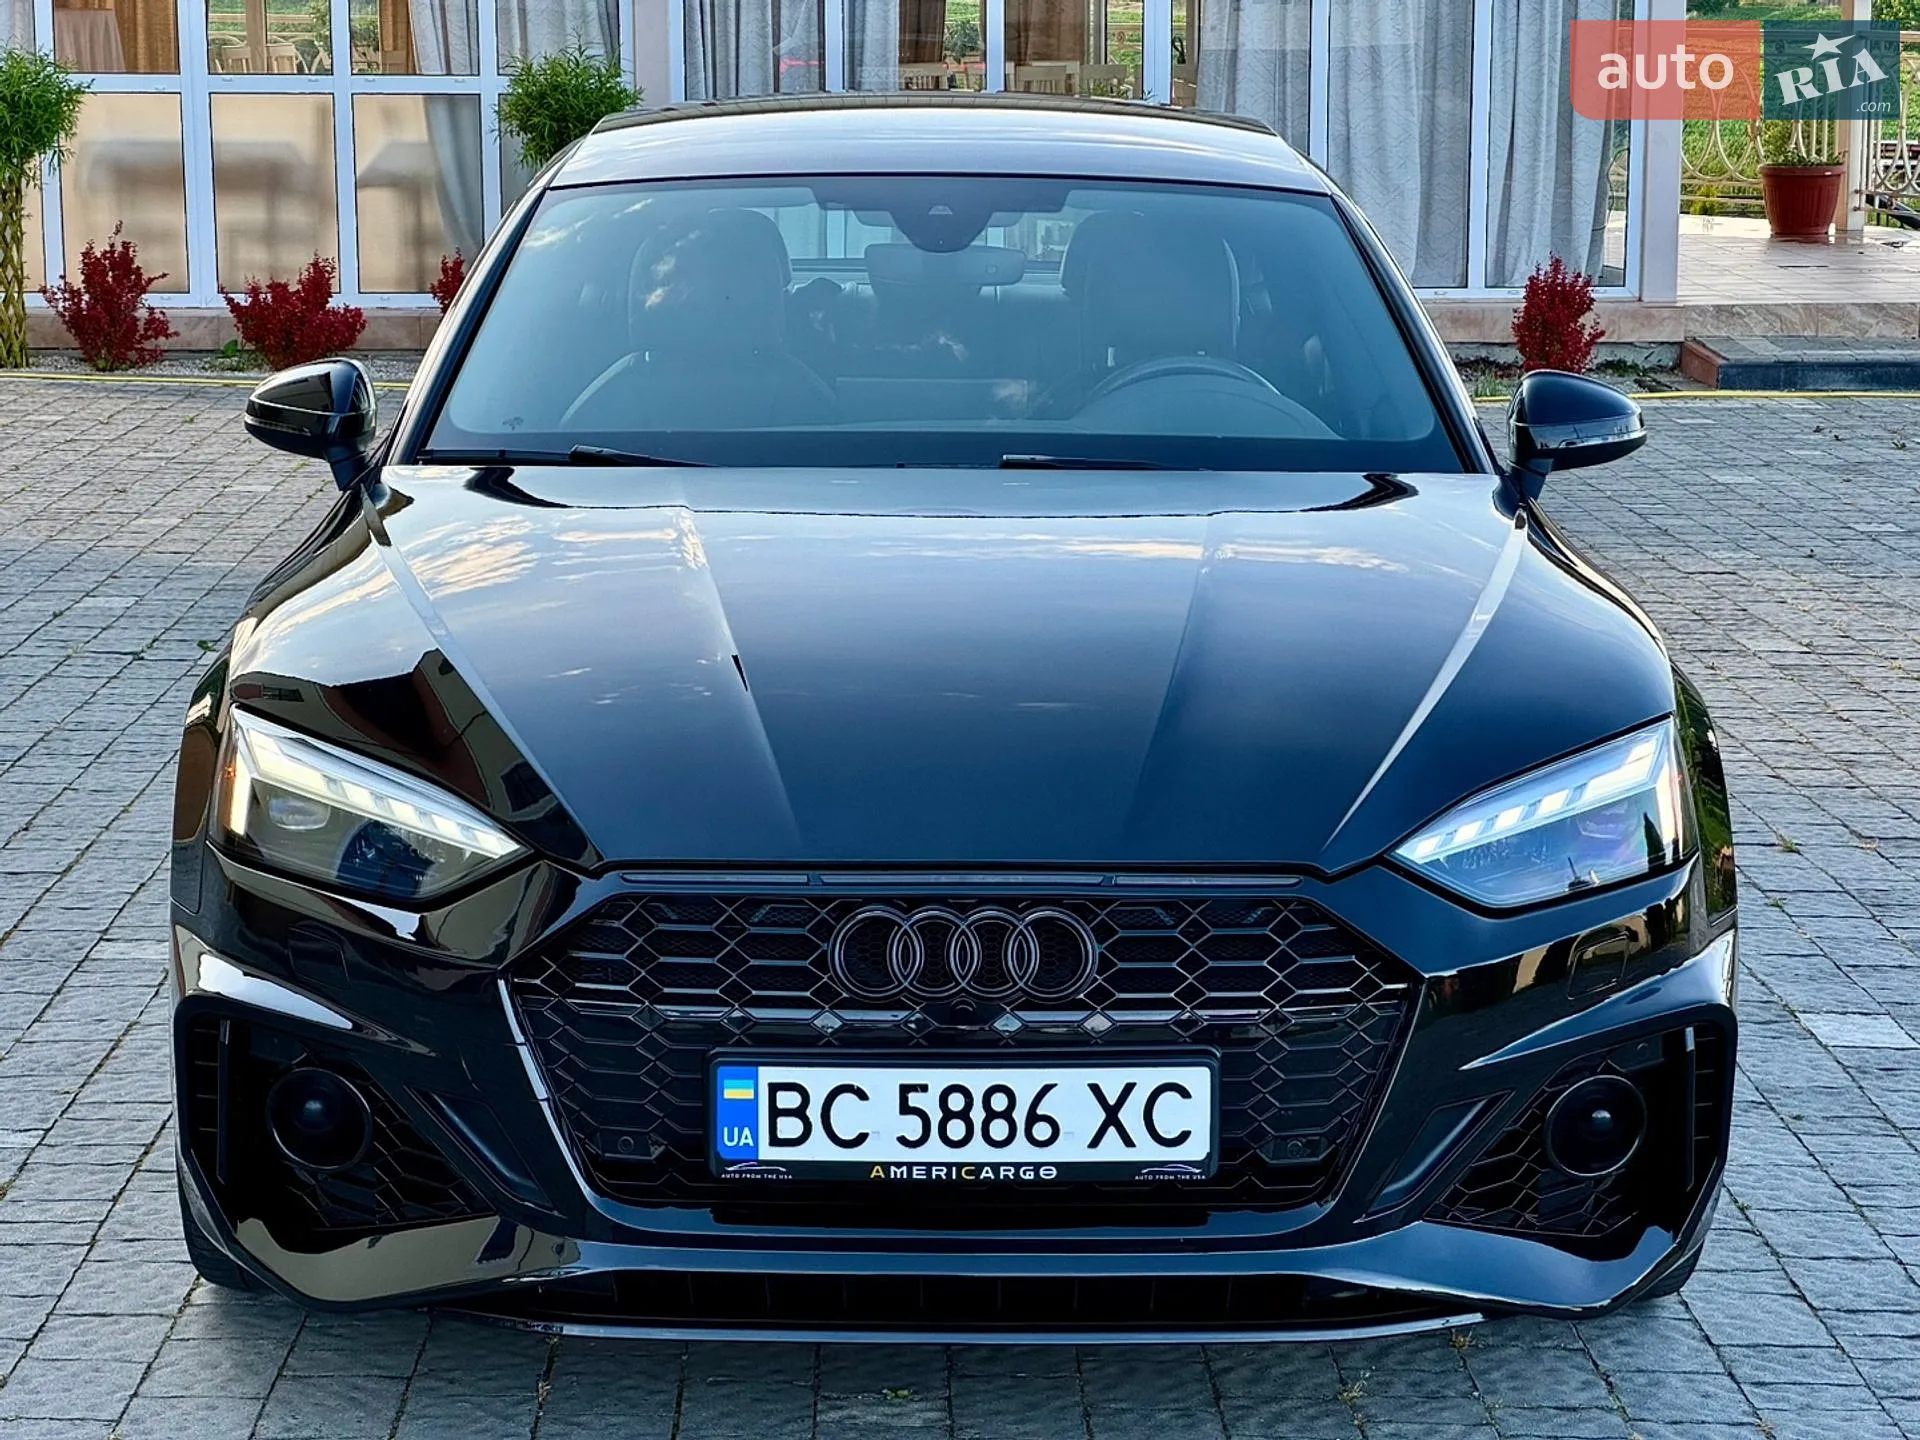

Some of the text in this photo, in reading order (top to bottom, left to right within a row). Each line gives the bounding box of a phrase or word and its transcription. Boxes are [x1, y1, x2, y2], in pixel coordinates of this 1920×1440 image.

[766, 1081, 1193, 1150] BC 5886 XC
[723, 1126, 755, 1147] UA
[869, 1165, 1058, 1180] AMERICARGO
